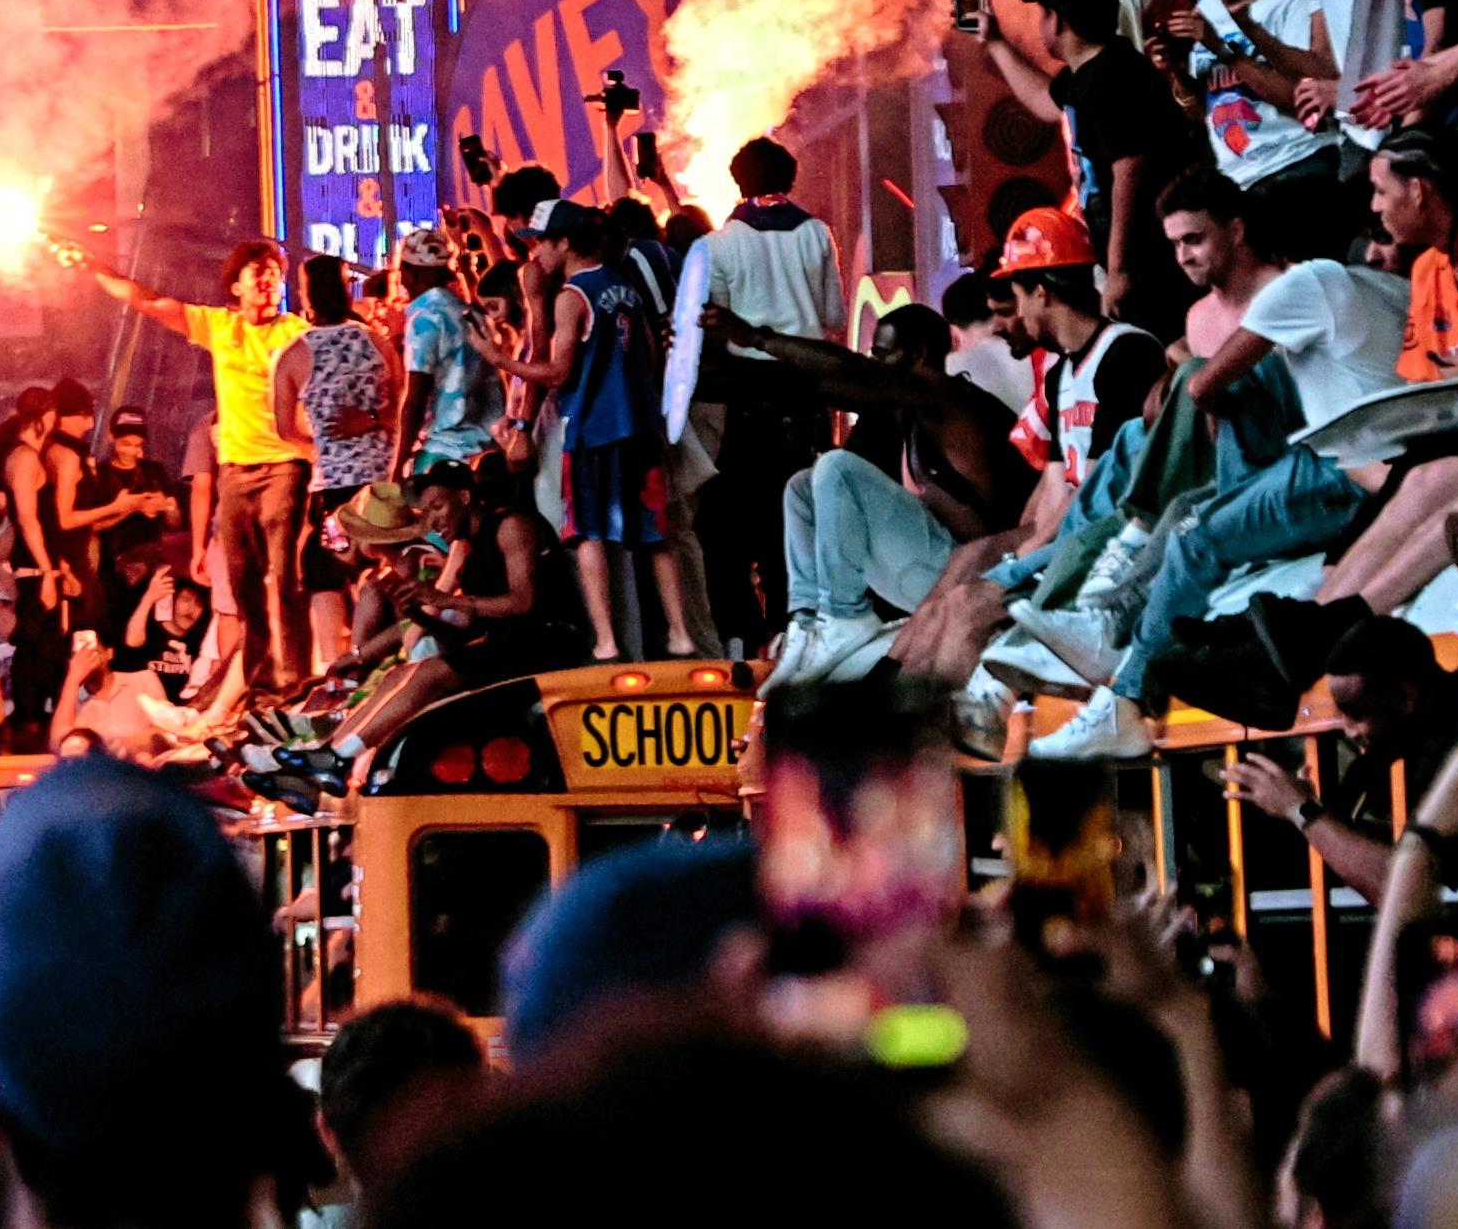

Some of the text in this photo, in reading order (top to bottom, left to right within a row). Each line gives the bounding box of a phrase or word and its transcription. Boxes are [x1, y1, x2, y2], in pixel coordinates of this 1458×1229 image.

[354, 79, 377, 120] &
[306, 123, 432, 175] DRINK
[355, 177, 383, 218] &
[309, 221, 432, 267] PL
[582, 702, 739, 767] SCHOOL
